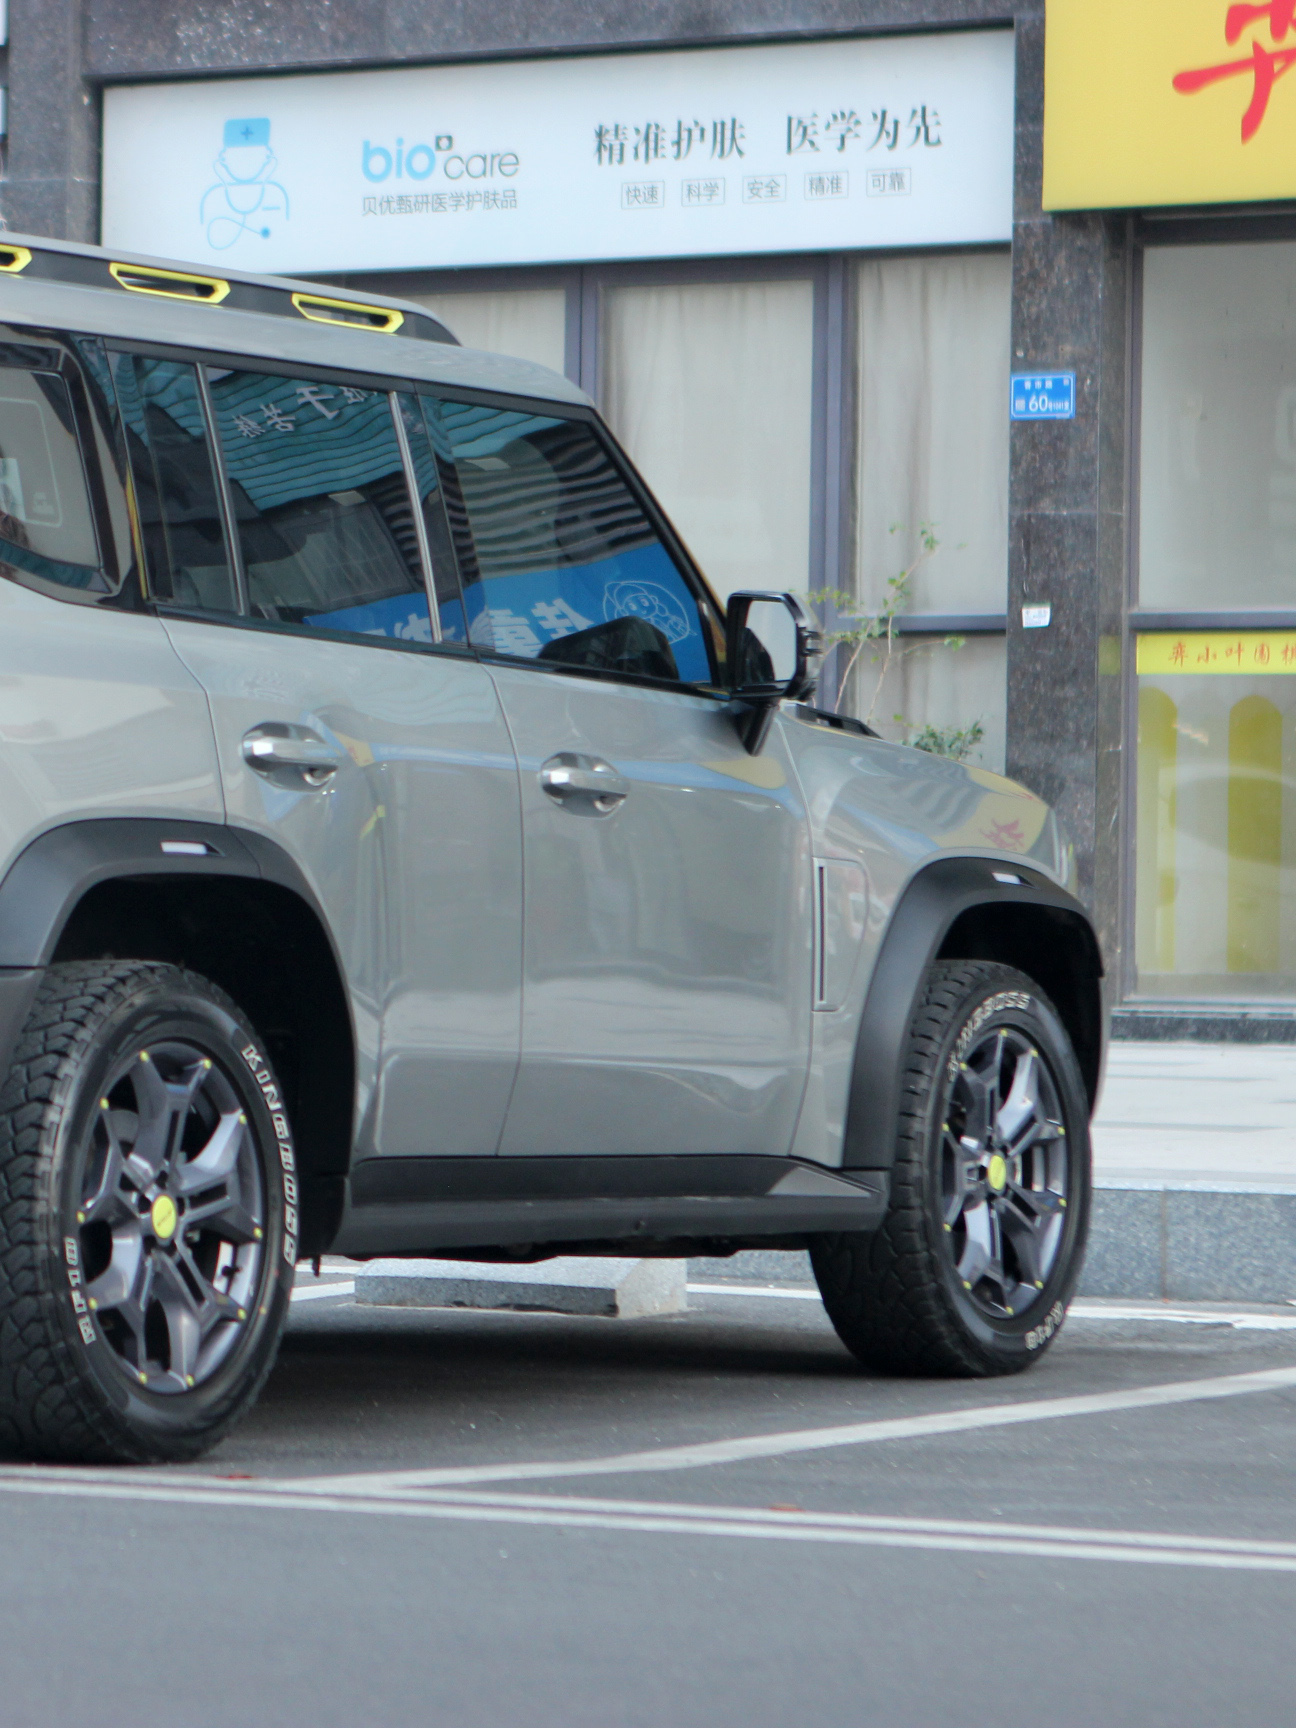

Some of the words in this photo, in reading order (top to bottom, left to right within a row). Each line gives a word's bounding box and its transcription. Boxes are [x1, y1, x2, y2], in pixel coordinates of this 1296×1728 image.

[594, 116, 747, 166] 精准护肤
[785, 105, 944, 155] 医学为先
[685, 182, 720, 203] 科学
[747, 179, 781, 199] 安全
[807, 175, 842, 196] 精准
[871, 171, 906, 193] 可靠
[362, 189, 518, 216] 贝优甄研医学护肤品
[625, 185, 659, 205] 快速
[241, 1043, 301, 1267] KINGBOSS
